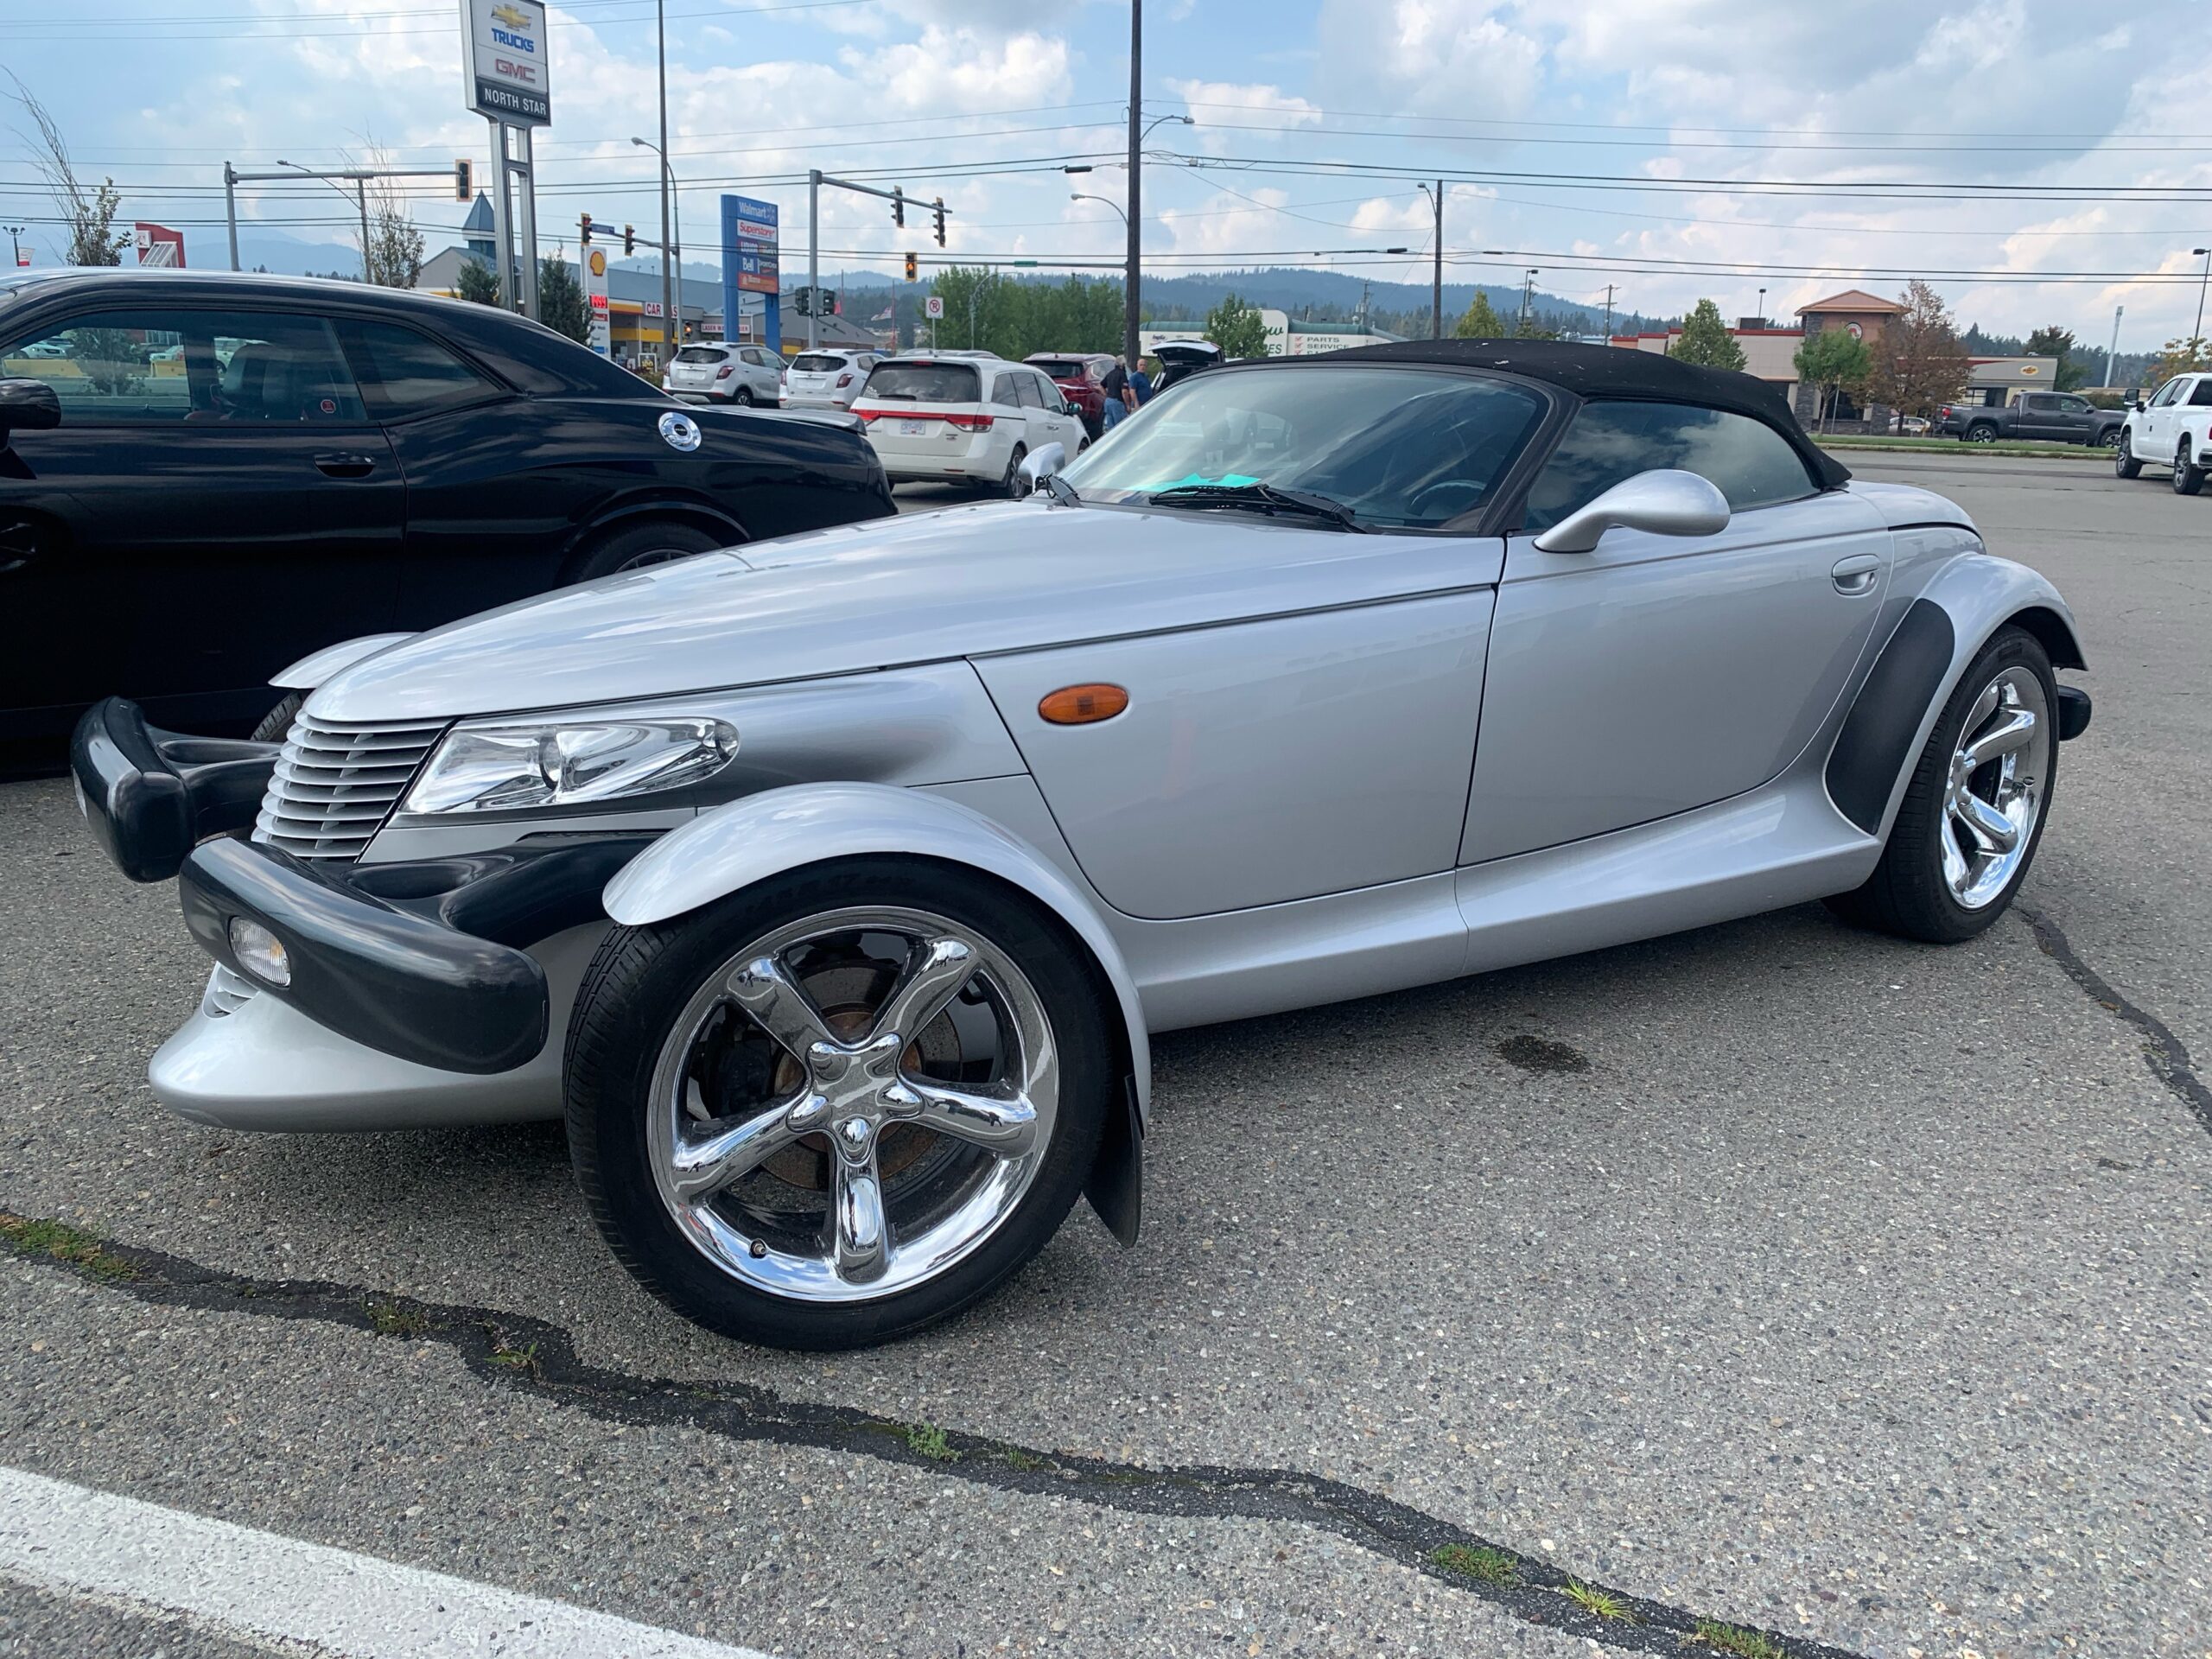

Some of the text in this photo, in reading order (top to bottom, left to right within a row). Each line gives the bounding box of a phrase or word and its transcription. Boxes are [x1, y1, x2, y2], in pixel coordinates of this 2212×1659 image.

[491, 28, 534, 53] TRUCKS
[495, 59, 536, 84] GMC
[484, 87, 546, 116] NORTH STAR
[739, 201, 766, 219] Walmart
[740, 221, 774, 238] Superstore
[742, 257, 754, 271] Bell
[646, 303, 662, 316] CAR
